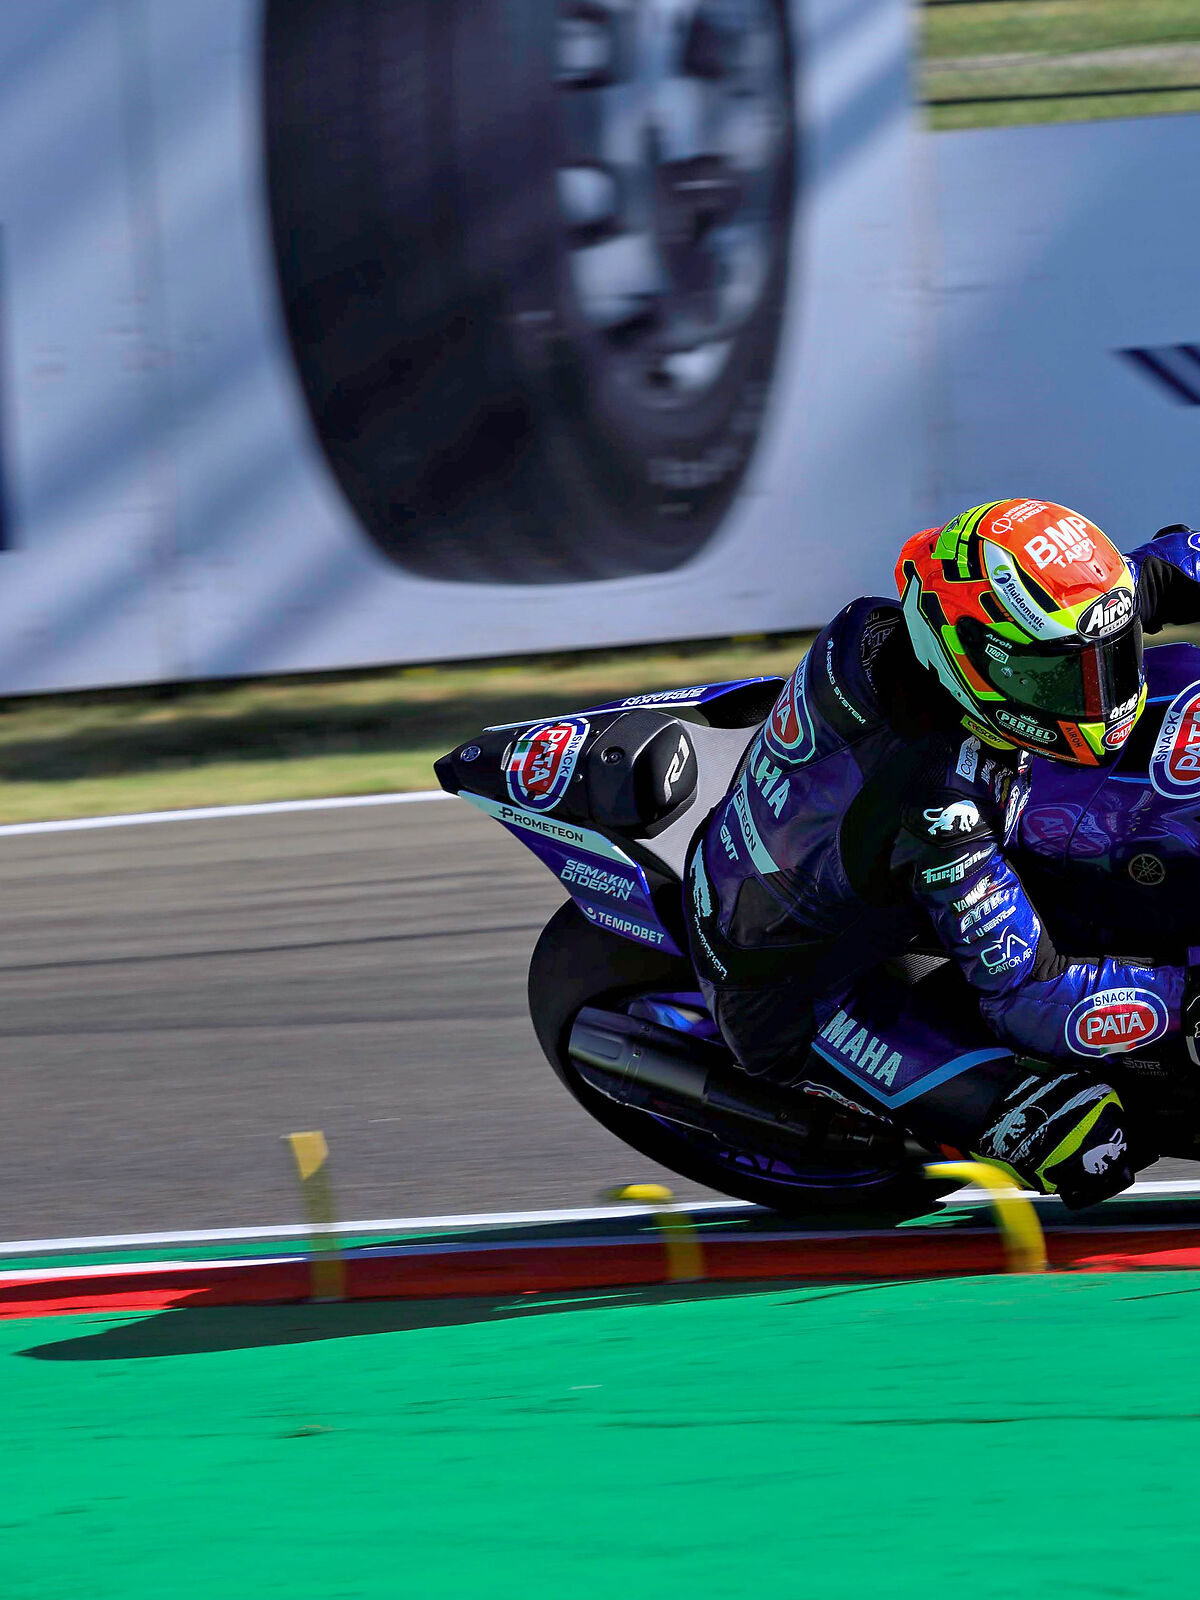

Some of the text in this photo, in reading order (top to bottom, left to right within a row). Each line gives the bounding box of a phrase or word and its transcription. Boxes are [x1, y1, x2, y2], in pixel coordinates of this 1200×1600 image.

[1024, 516, 1088, 570] BMP
[1053, 538, 1096, 568] TAPPI
[1006, 582, 1045, 628] fluidomatic
[1085, 591, 1132, 633] Airoh
[985, 633, 1013, 649] Airoh
[988, 646, 1007, 661] 100%
[834, 686, 866, 724] SYSTEM
[1001, 713, 1050, 740] PERREL
[1066, 727, 1083, 748] AIROH
[1155, 711, 1181, 763] SNACK
[528, 729, 567, 784] PATA
[560, 736, 581, 776] SNACK
[498, 806, 584, 843] PROMETEON
[565, 860, 635, 891] SEMAKIN
[577, 875, 630, 901] DEPAN
[598, 912, 664, 944] TEMPOBET
[988, 948, 1033, 975] CANTOR AIR
[1095, 991, 1134, 1007] SNACK
[1087, 1011, 1146, 1040] PATA
